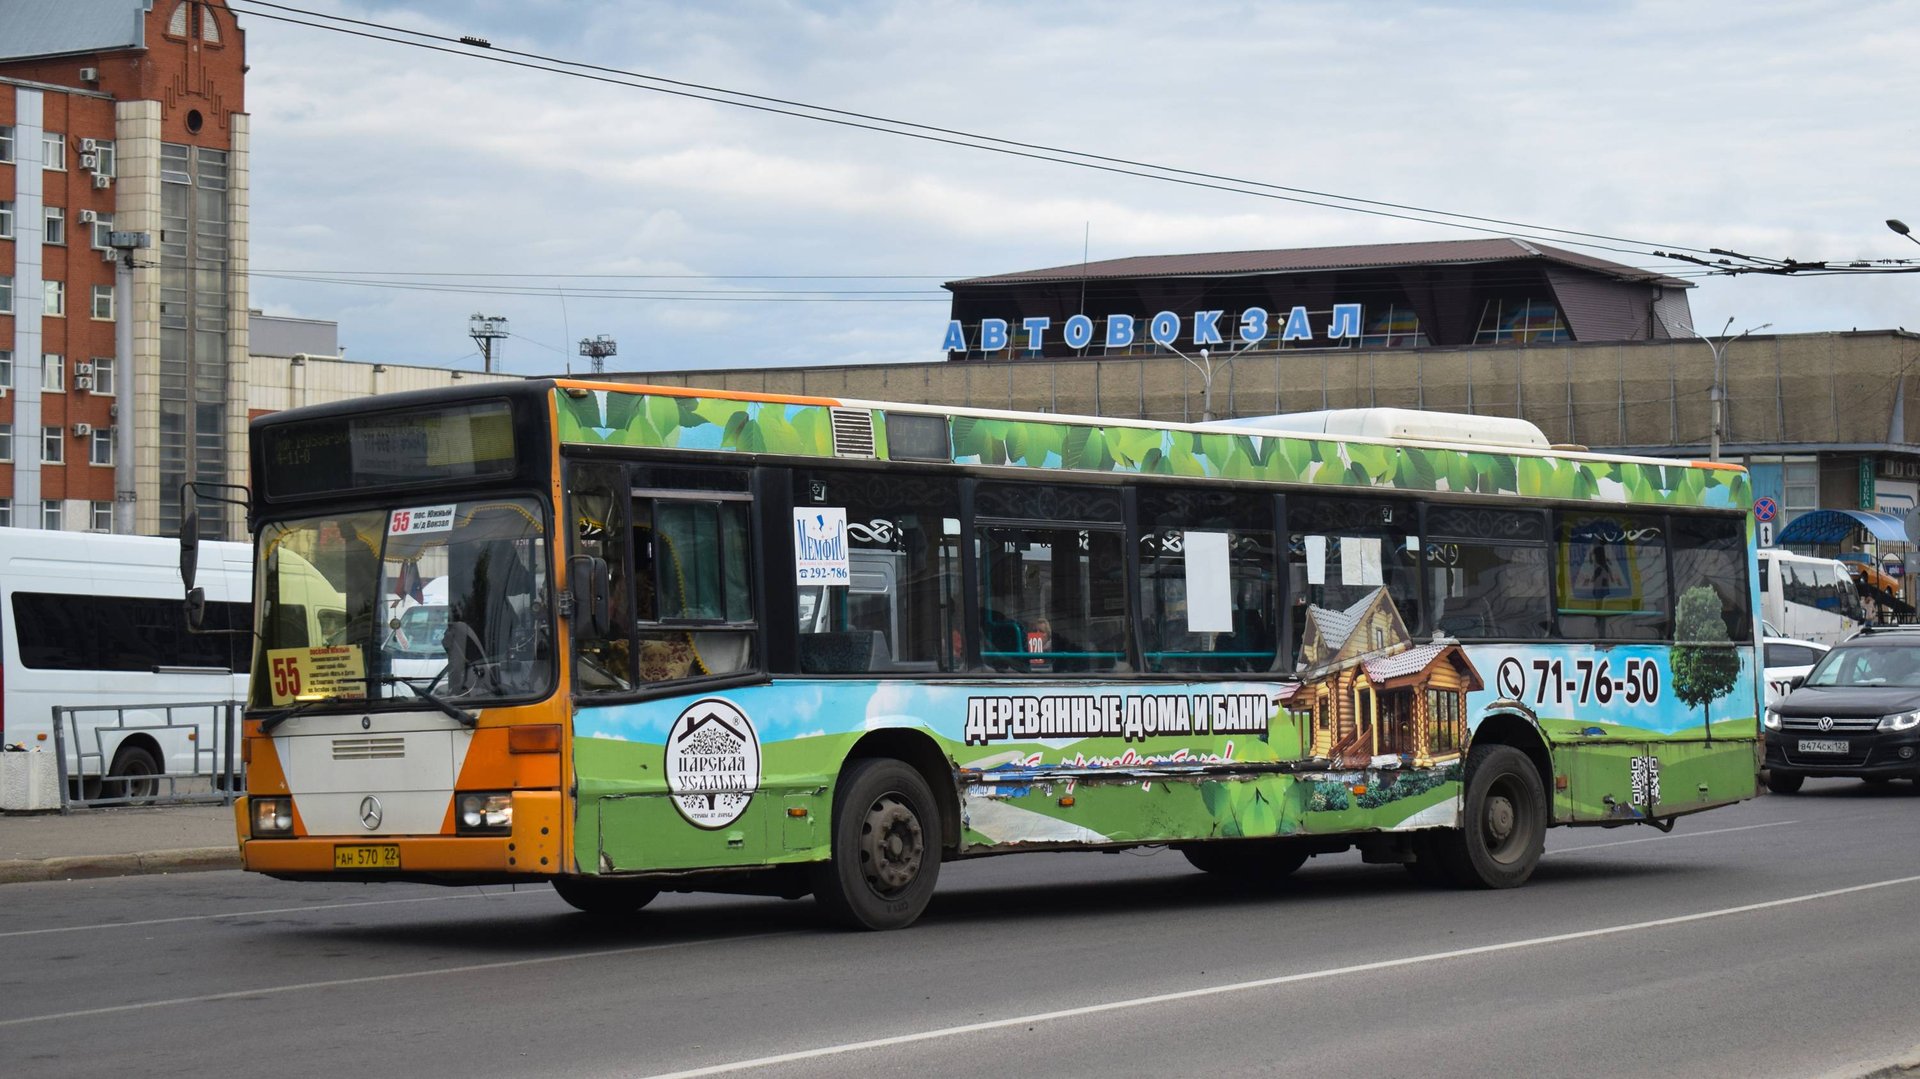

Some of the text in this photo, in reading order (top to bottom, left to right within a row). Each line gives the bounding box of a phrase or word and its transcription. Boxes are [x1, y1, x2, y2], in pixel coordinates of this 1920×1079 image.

[941, 303, 1362, 353] АВТОВОКЗАЛ
[1862, 464, 1870, 508] АПТЕКА
[392, 511, 410, 533] 55
[427, 508, 452, 518] Южный
[810, 567, 847, 578] 292-786
[273, 657, 301, 697] 55
[1533, 660, 1659, 704] 71-76-50
[965, 694, 1268, 746] ДЕРЕВЯННЫЕ ДОМА И БАНИ
[678, 756, 746, 772] ЦАРСКАЯ
[678, 774, 748, 791] УСАДЬБА
[341, 847, 396, 865] АН 570 22
